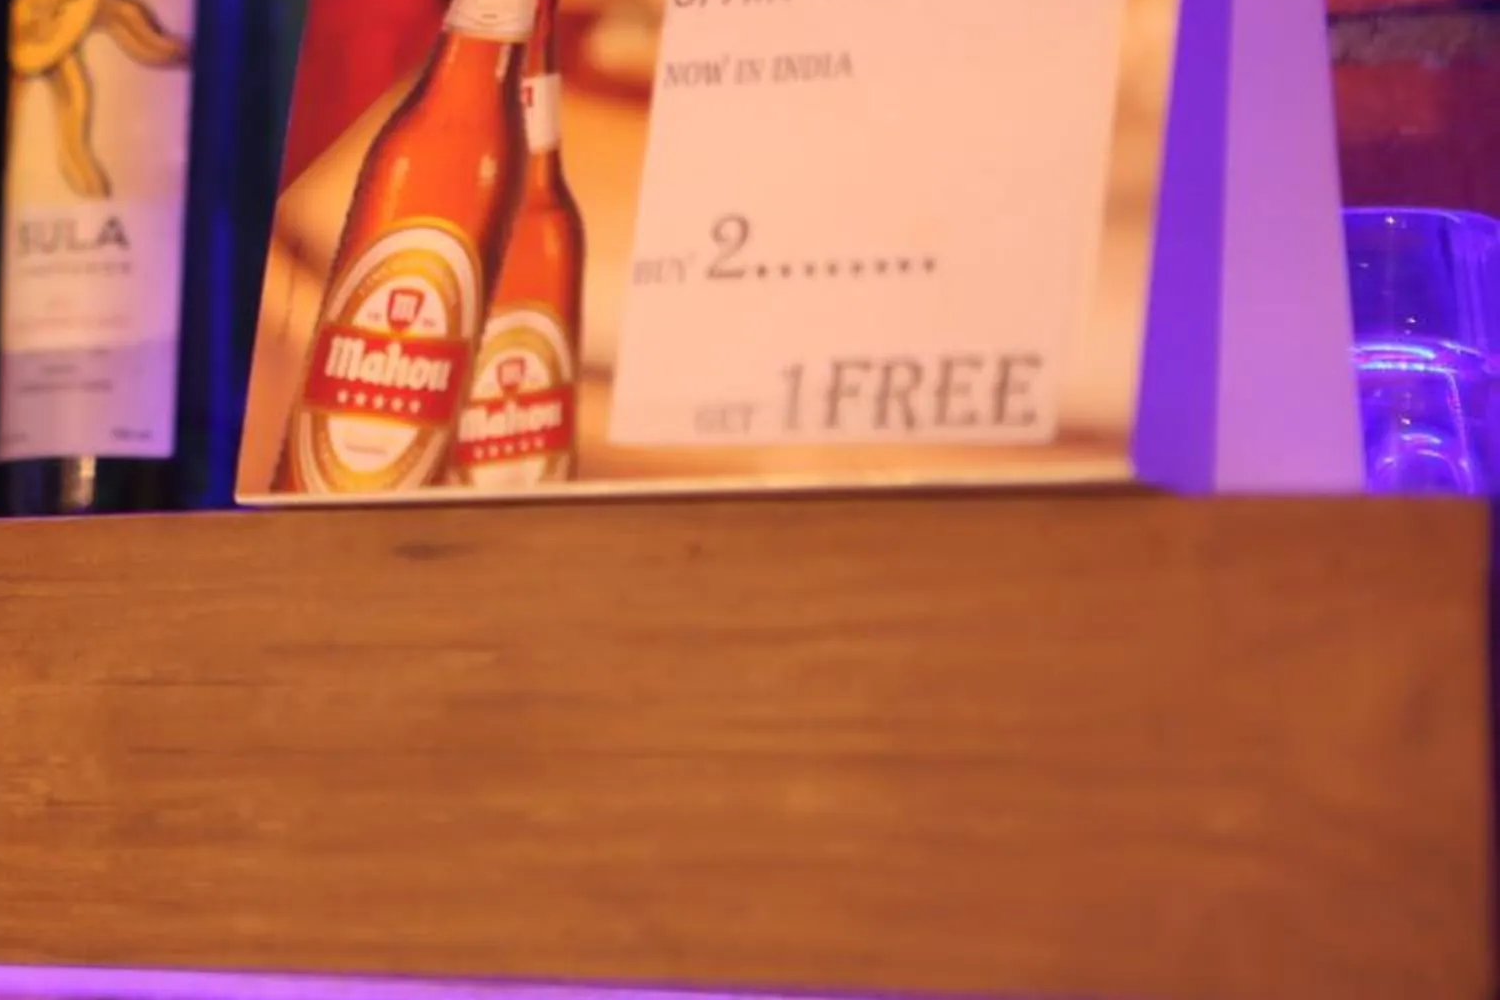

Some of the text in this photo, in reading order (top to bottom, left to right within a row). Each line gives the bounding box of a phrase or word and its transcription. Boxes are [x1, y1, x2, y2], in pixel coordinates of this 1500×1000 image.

[663, 51, 854, 88] NOW IN INDIA
[324, 336, 450, 391] Mahou
[780, 362, 805, 432] 1
[821, 353, 1046, 433] FREE
